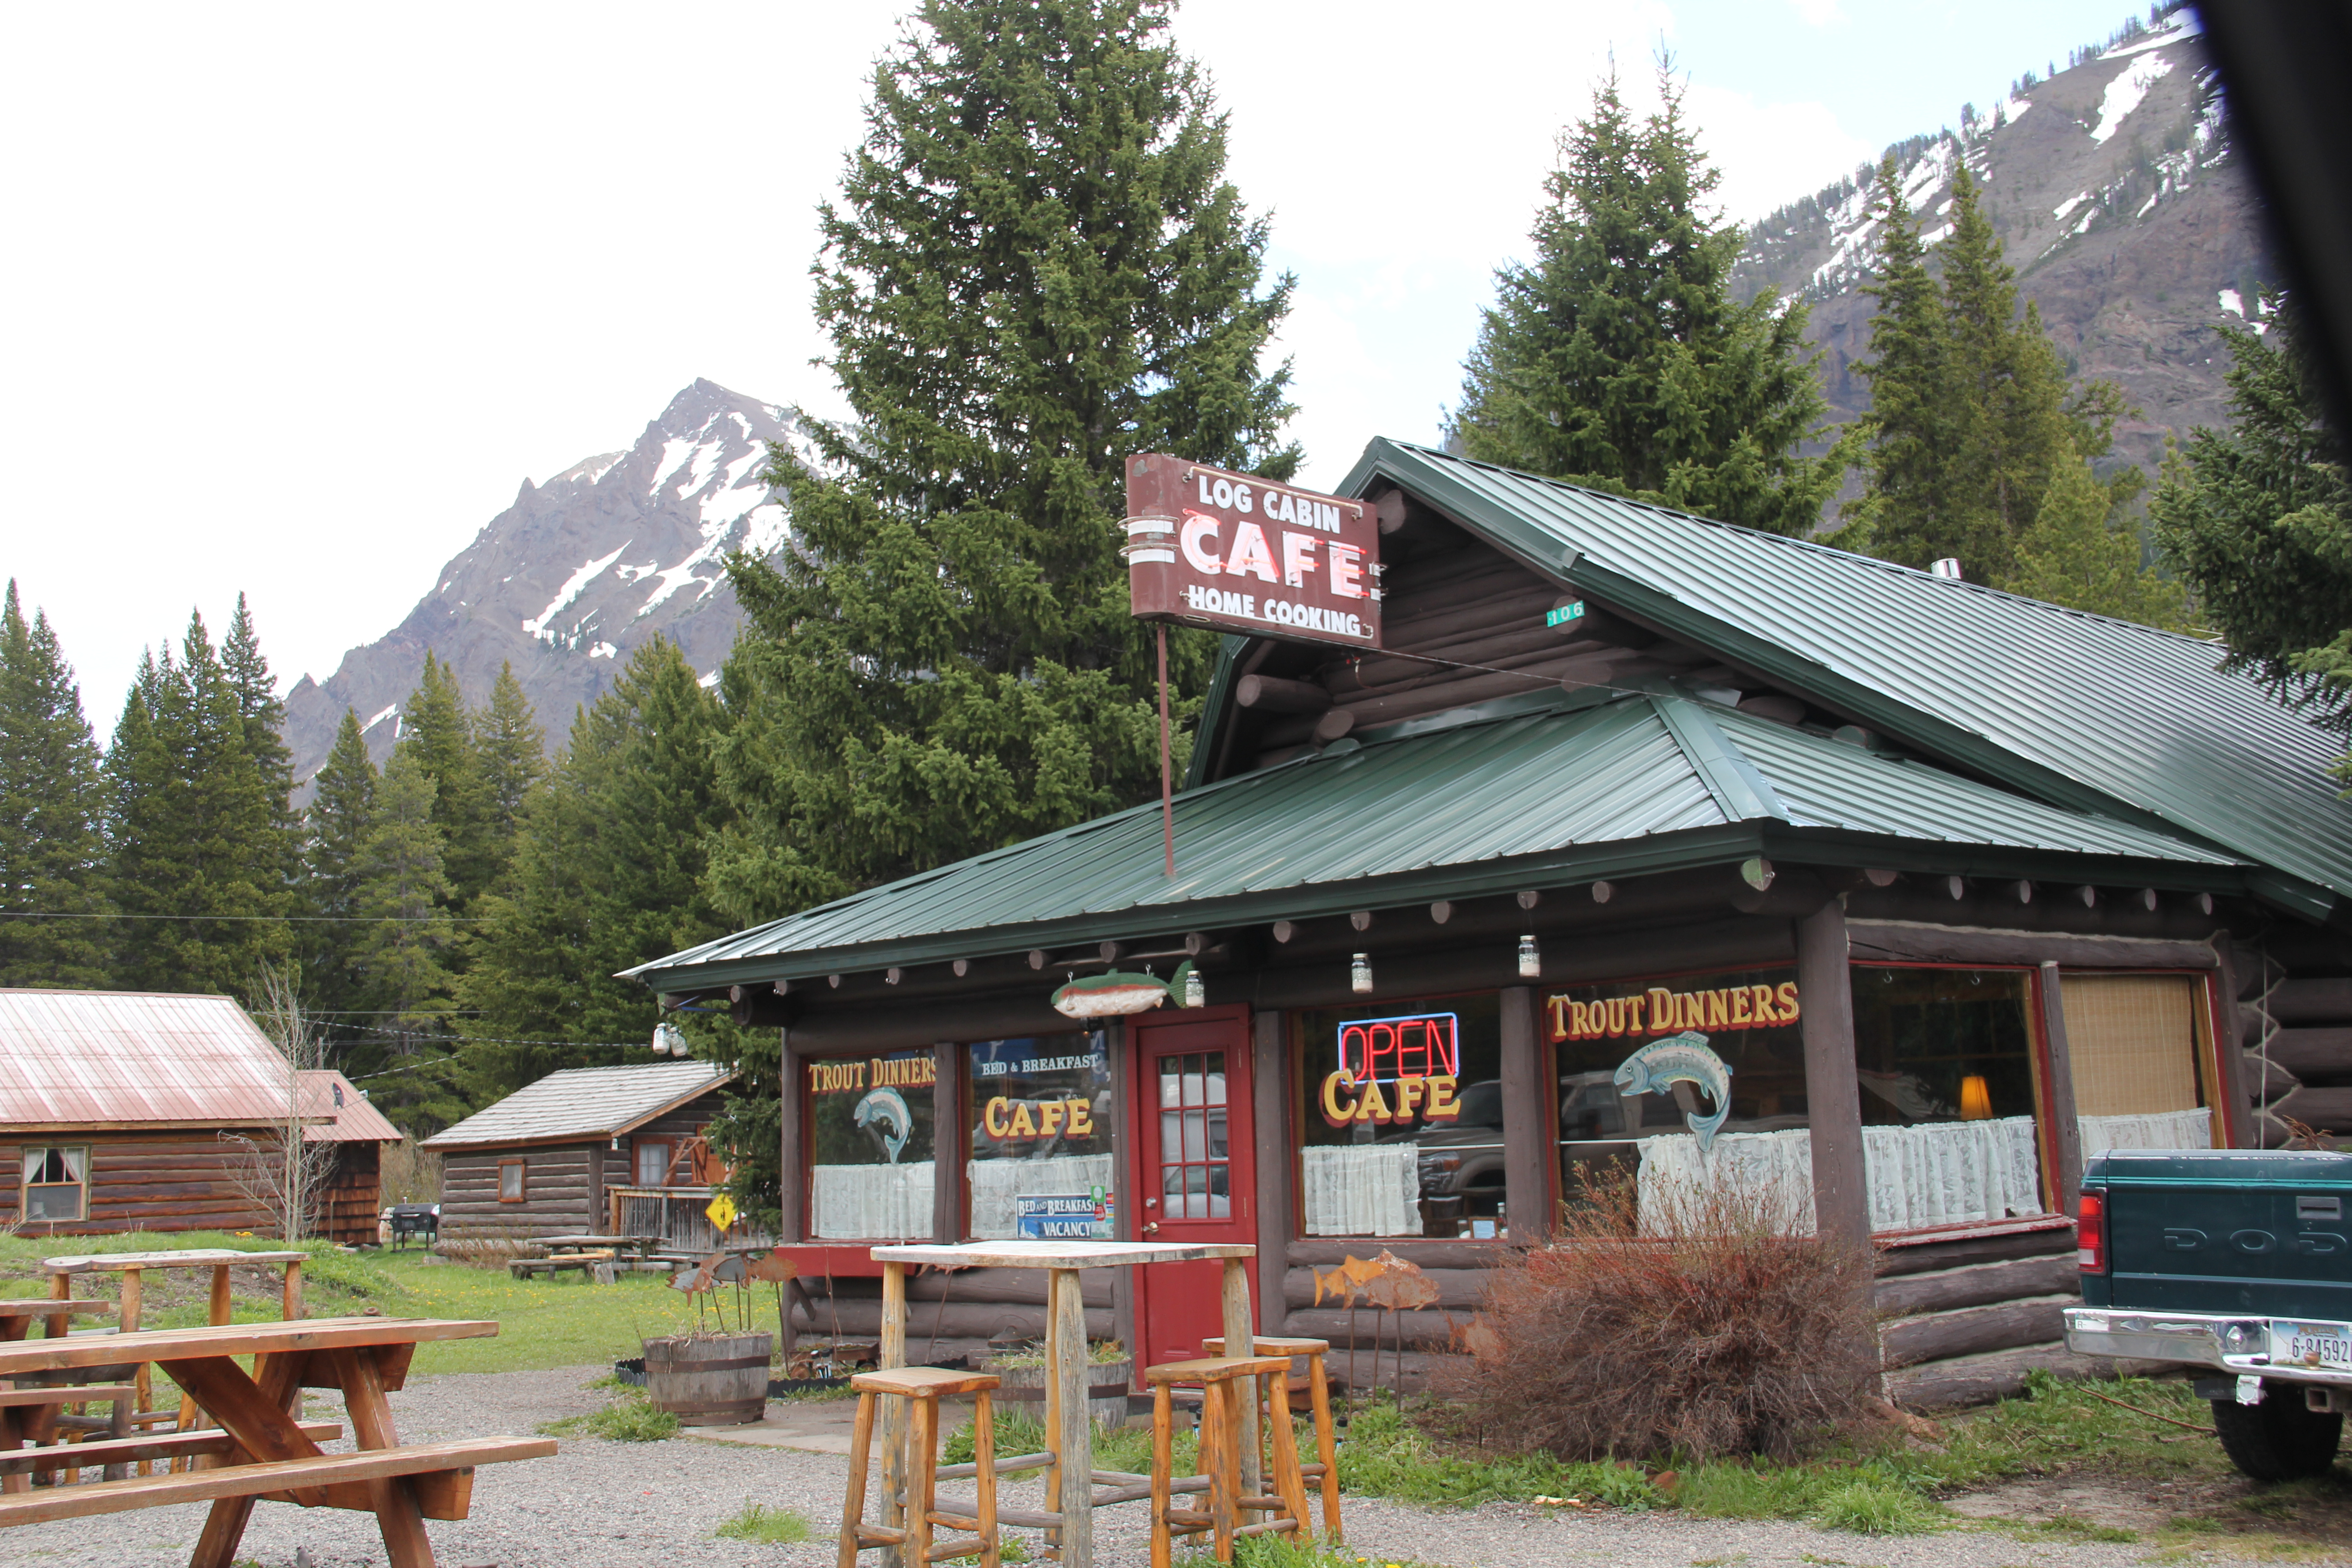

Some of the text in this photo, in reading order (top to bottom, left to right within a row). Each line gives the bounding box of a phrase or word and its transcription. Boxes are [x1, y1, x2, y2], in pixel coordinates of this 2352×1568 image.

[1199, 475, 1340, 534] LOG CABIN
[1180, 514, 1364, 599] CAFE
[1188, 584, 1361, 636] HOME COOKING
[1552, 602, 1582, 625] 106
[1548, 981, 1800, 1040] TROUT DINNERS
[982, 1061, 1007, 1076] BED
[1010, 1062, 1018, 1073] &
[1022, 1054, 1098, 1073] BREAKFAST
[1342, 1018, 1455, 1081] OPEN
[808, 1062, 866, 1093] TROUT
[1320, 1068, 1461, 1125] CAFE
[983, 1096, 1093, 1139] CAFE
[1018, 1200, 1035, 1216] BED
[1036, 1201, 1048, 1212] AND
[1044, 1221, 1091, 1237] VACANCY
